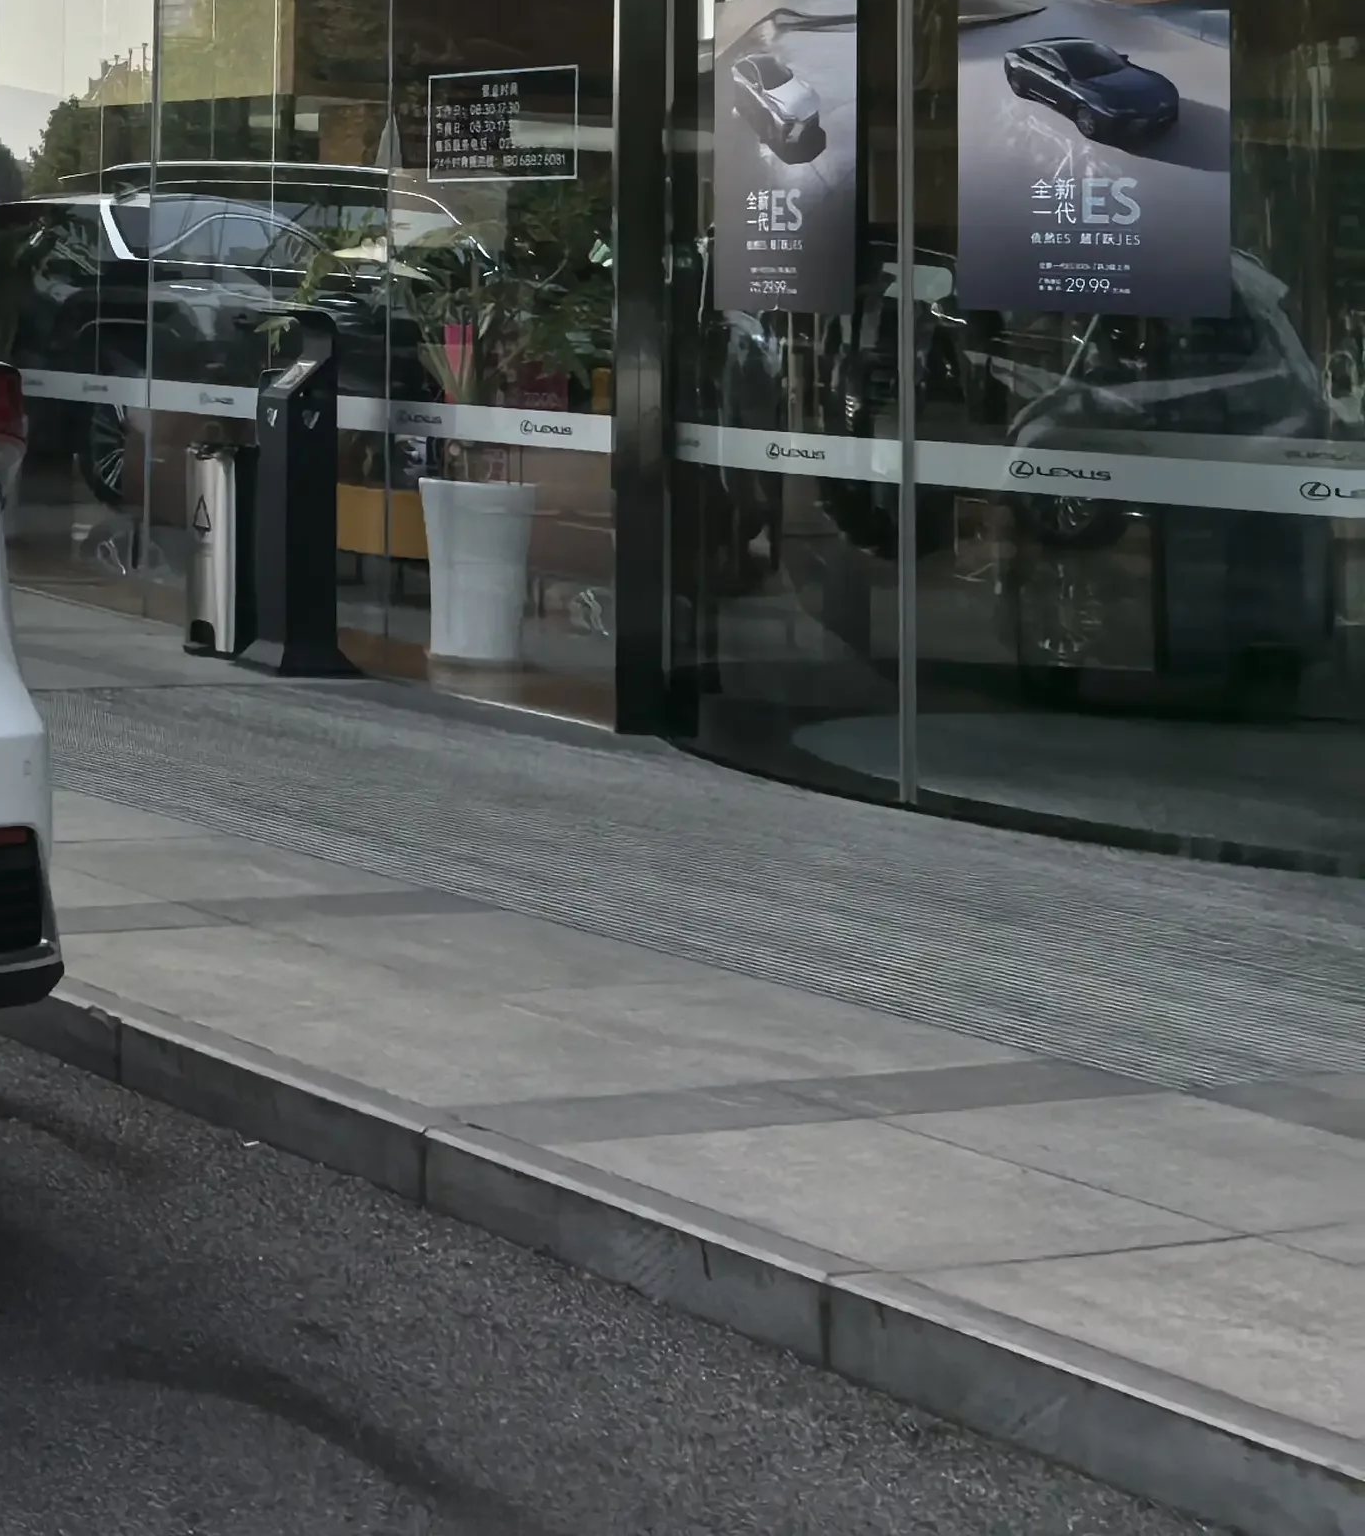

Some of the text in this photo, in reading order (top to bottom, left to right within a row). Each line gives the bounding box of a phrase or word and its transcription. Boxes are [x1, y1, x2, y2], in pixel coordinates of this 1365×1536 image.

[1030, 178, 1077, 200] 全新
[771, 188, 803, 231] ES
[1081, 177, 1141, 225] ES
[1031, 202, 1077, 224] 一代
[1065, 277, 1110, 293] 29.99
[533, 423, 573, 436] LEXUS
[780, 448, 826, 461] LEXUS
[1036, 466, 1112, 482] LEXUS
